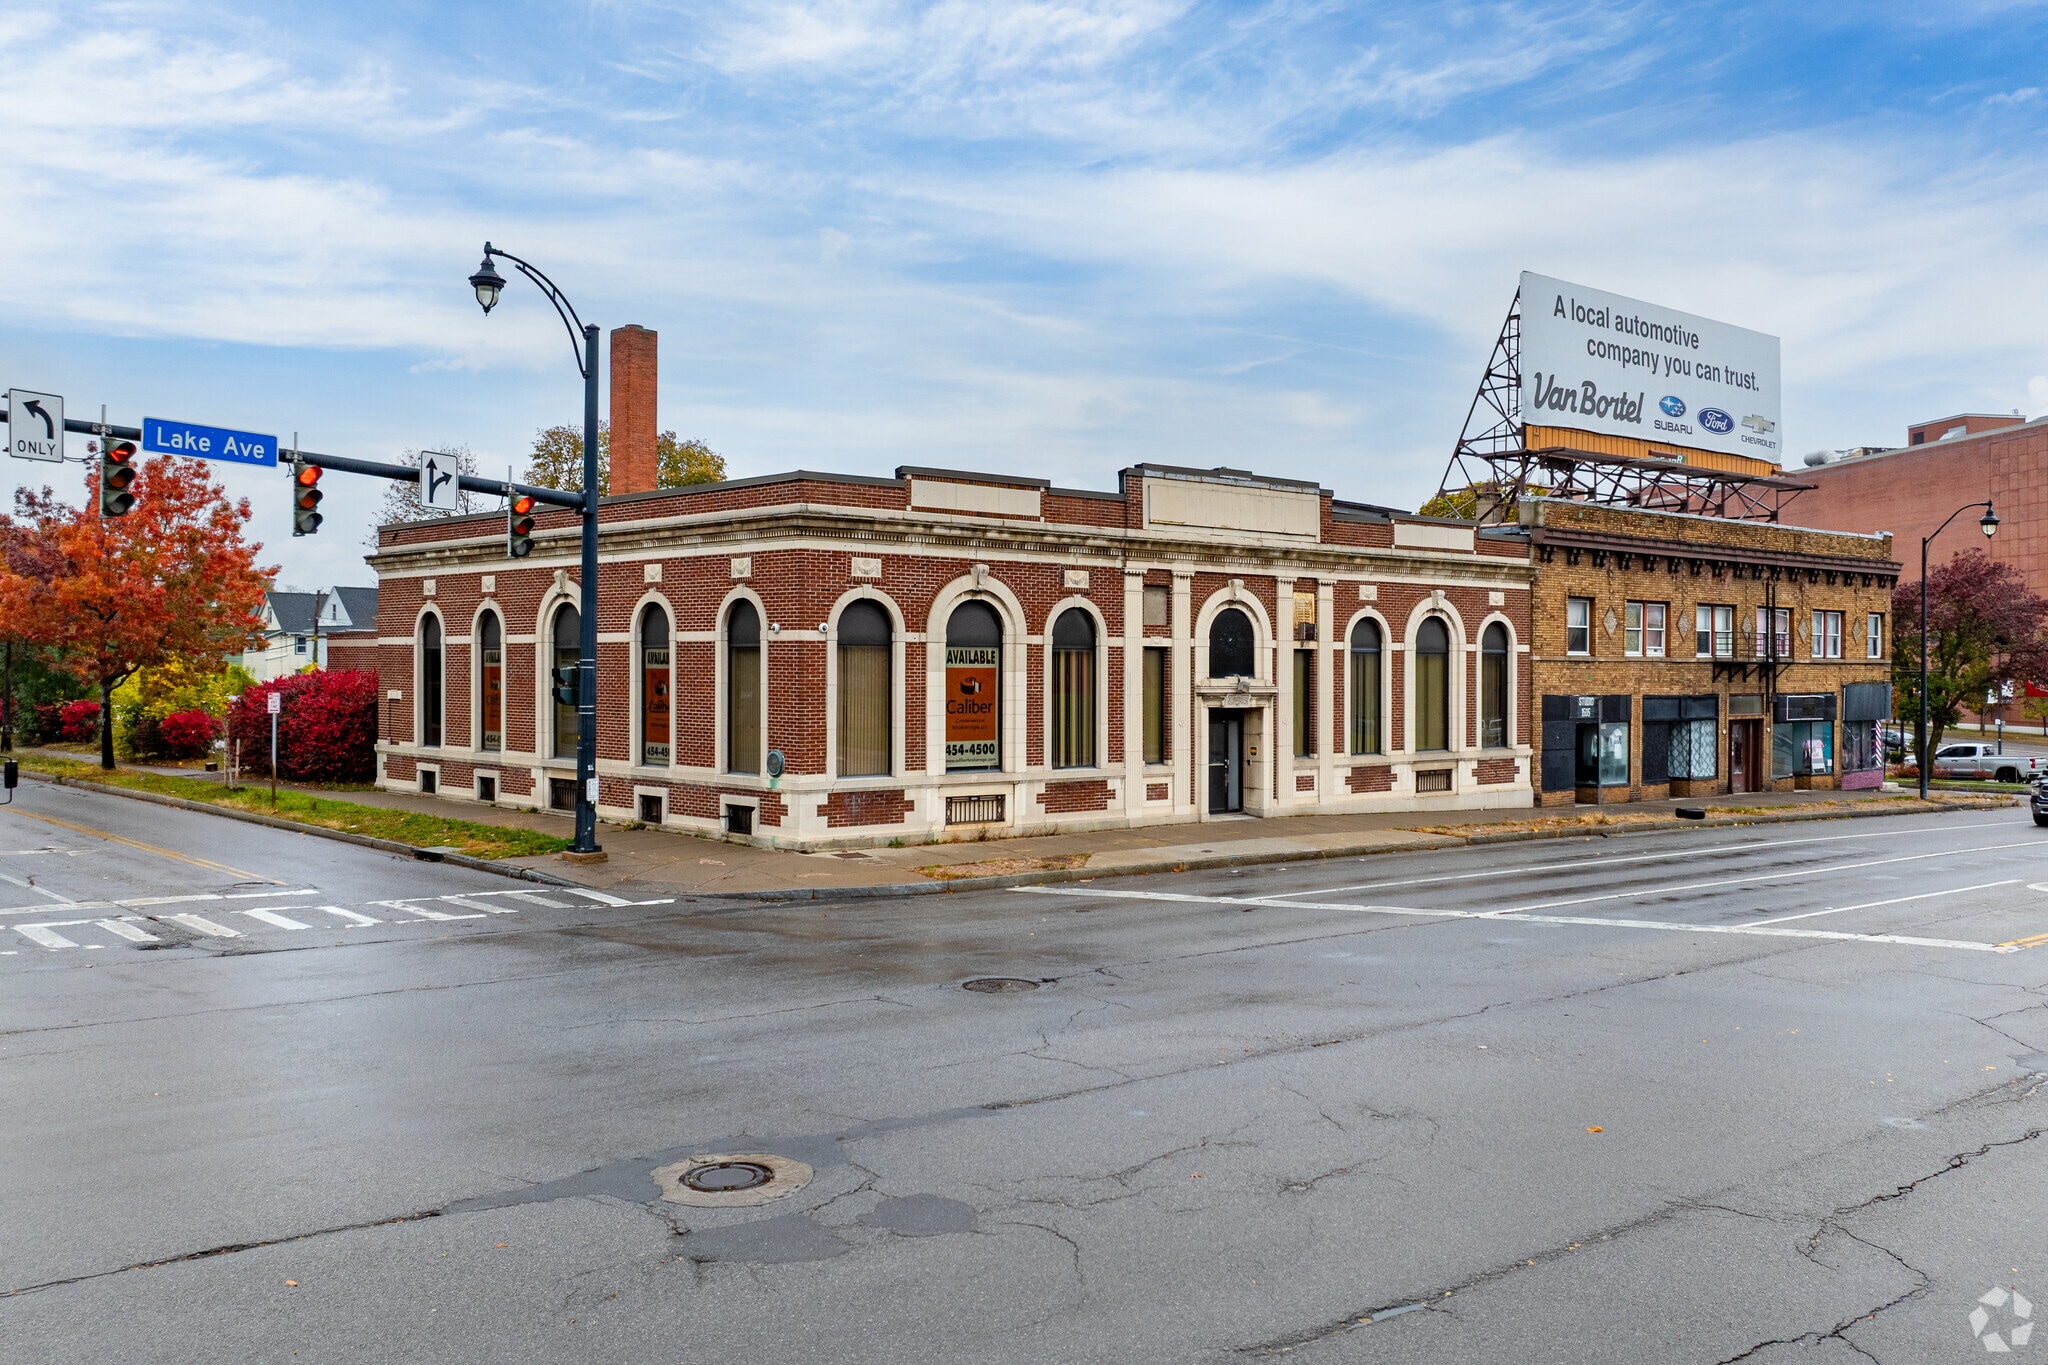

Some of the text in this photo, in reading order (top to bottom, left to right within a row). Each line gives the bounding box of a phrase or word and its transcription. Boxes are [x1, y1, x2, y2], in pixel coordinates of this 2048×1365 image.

[1553, 294, 1699, 350] A local automotive
[1587, 338, 1760, 392] company you can trust.
[1654, 419, 1693, 435] SUBARU
[1705, 411, 1729, 431] Ford
[17, 439, 56, 456] ONLY
[157, 426, 265, 459] Lake Ave
[1741, 434, 1776, 449] CHEVROLET
[946, 649, 996, 665] AVAILABLE
[946, 698, 993, 714] Caliber
[946, 743, 995, 756] 454-4500
